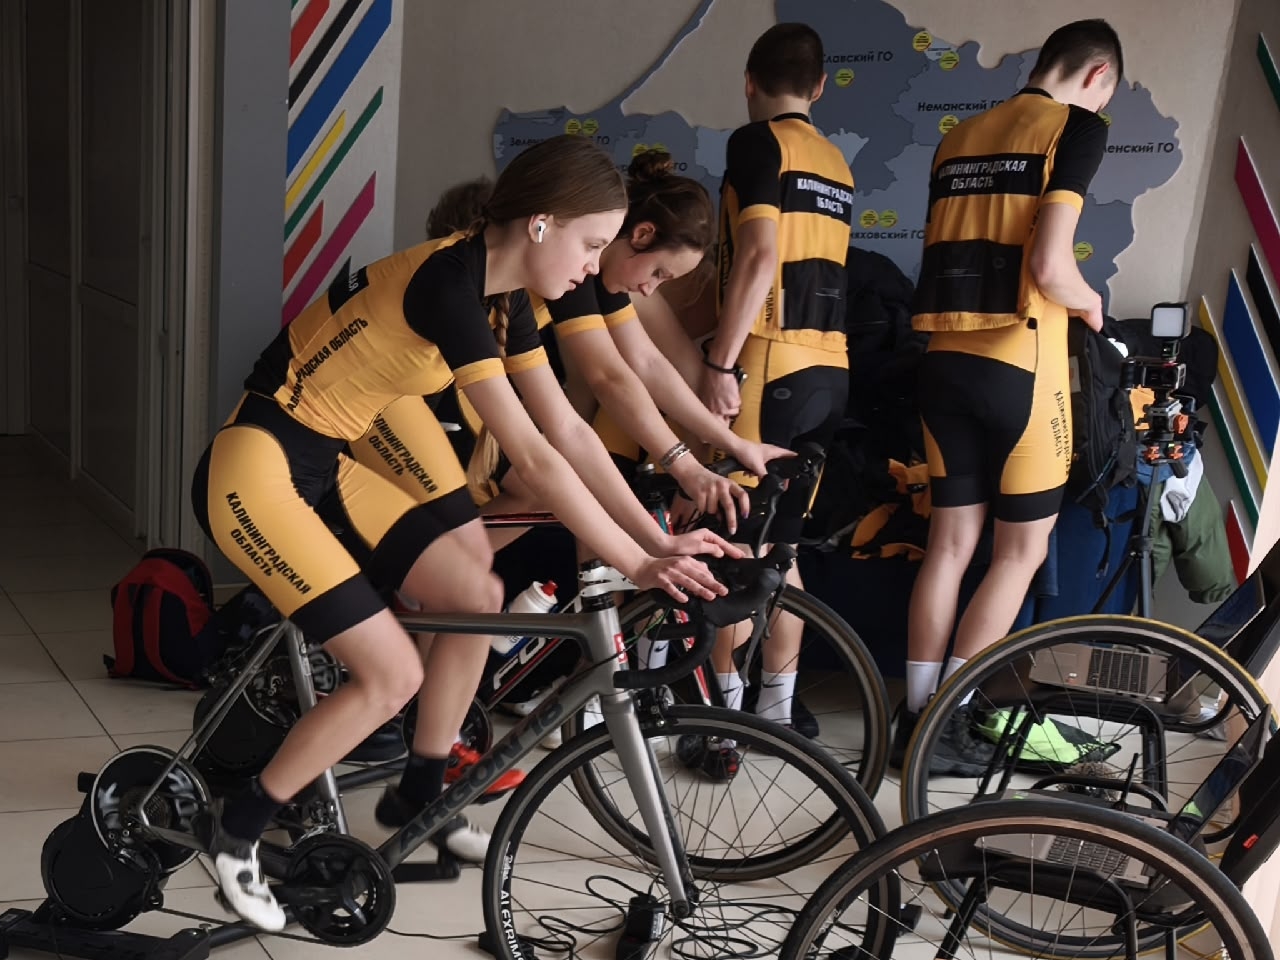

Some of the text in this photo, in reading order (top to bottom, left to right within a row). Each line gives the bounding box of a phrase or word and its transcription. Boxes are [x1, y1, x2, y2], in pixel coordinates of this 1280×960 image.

[878, 50, 893, 61] ГО
[917, 100, 987, 112] Неманский
[1158, 142, 1174, 153] ГО
[951, 176, 995, 191] ОБЛАСТЬ
[330, 317, 369, 351] ОБЛАСТЬ
[368, 434, 405, 477] ОБЛАСТЬ
[225, 491, 312, 595] КАЛИНИНГРАДСКАЯ
[230, 528, 274, 578] ОБЛАСТЬ
[396, 740, 523, 853] ARGON
